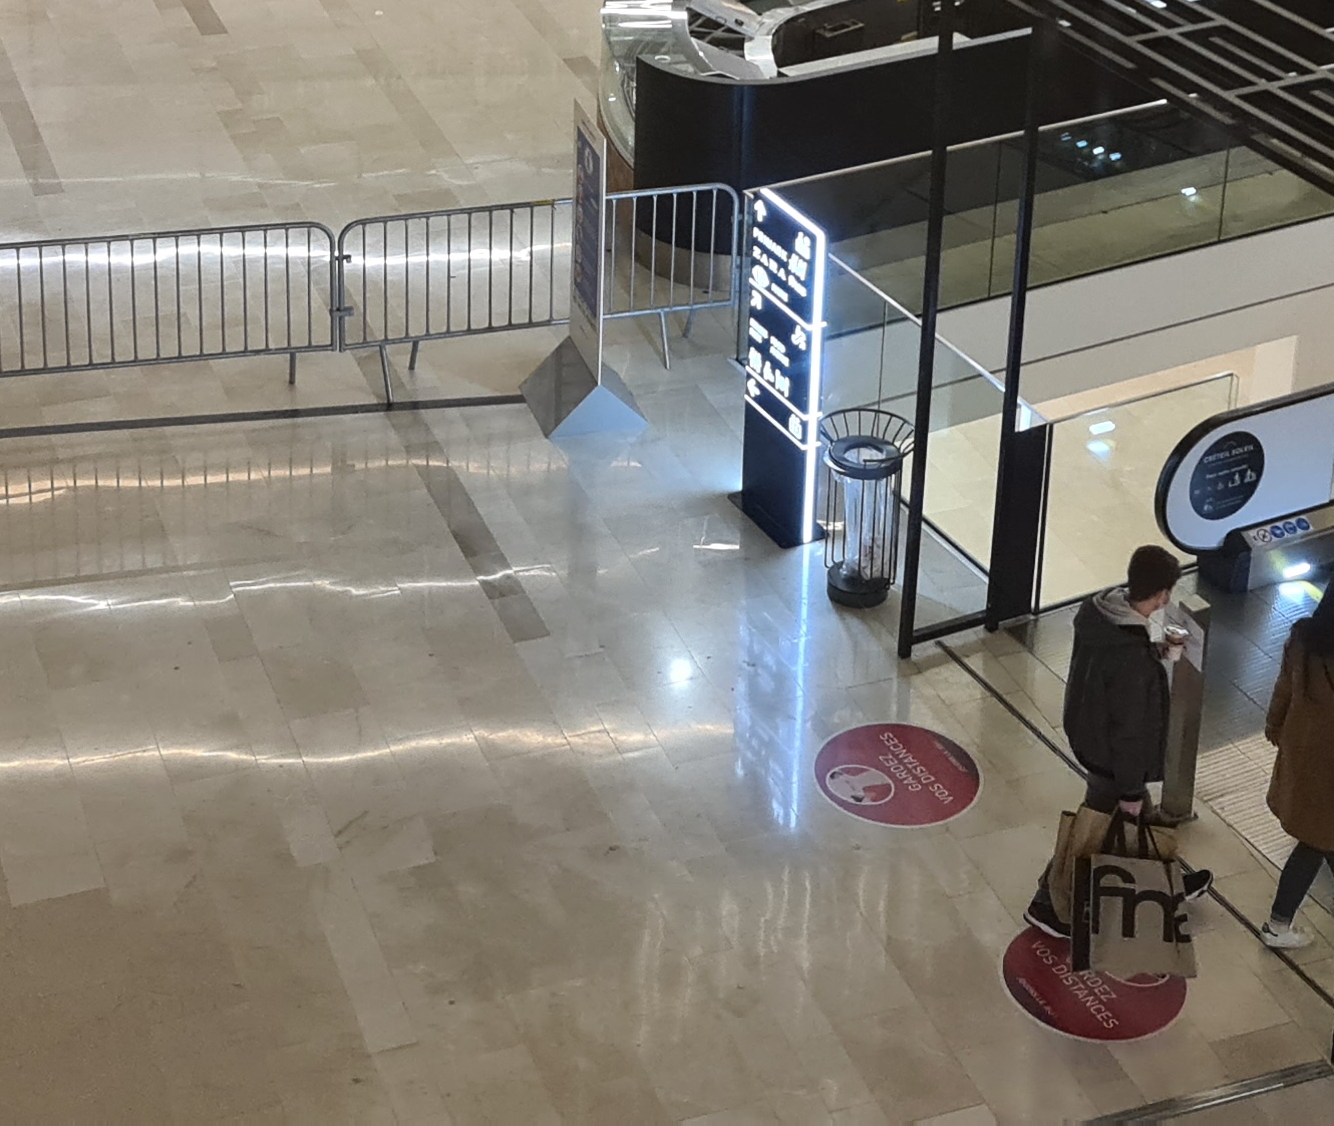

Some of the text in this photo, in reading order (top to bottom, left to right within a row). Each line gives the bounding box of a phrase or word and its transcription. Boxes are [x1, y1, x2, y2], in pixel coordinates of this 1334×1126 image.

[752, 245, 787, 281] ZARA
[879, 731, 935, 785] DISTANCES
[879, 753, 923, 793] GARDEZ
[929, 783, 955, 805] VOS
[1031, 940, 1119, 1029] VOS DISTANCES
[1066, 956, 1118, 1002] RDEZ
